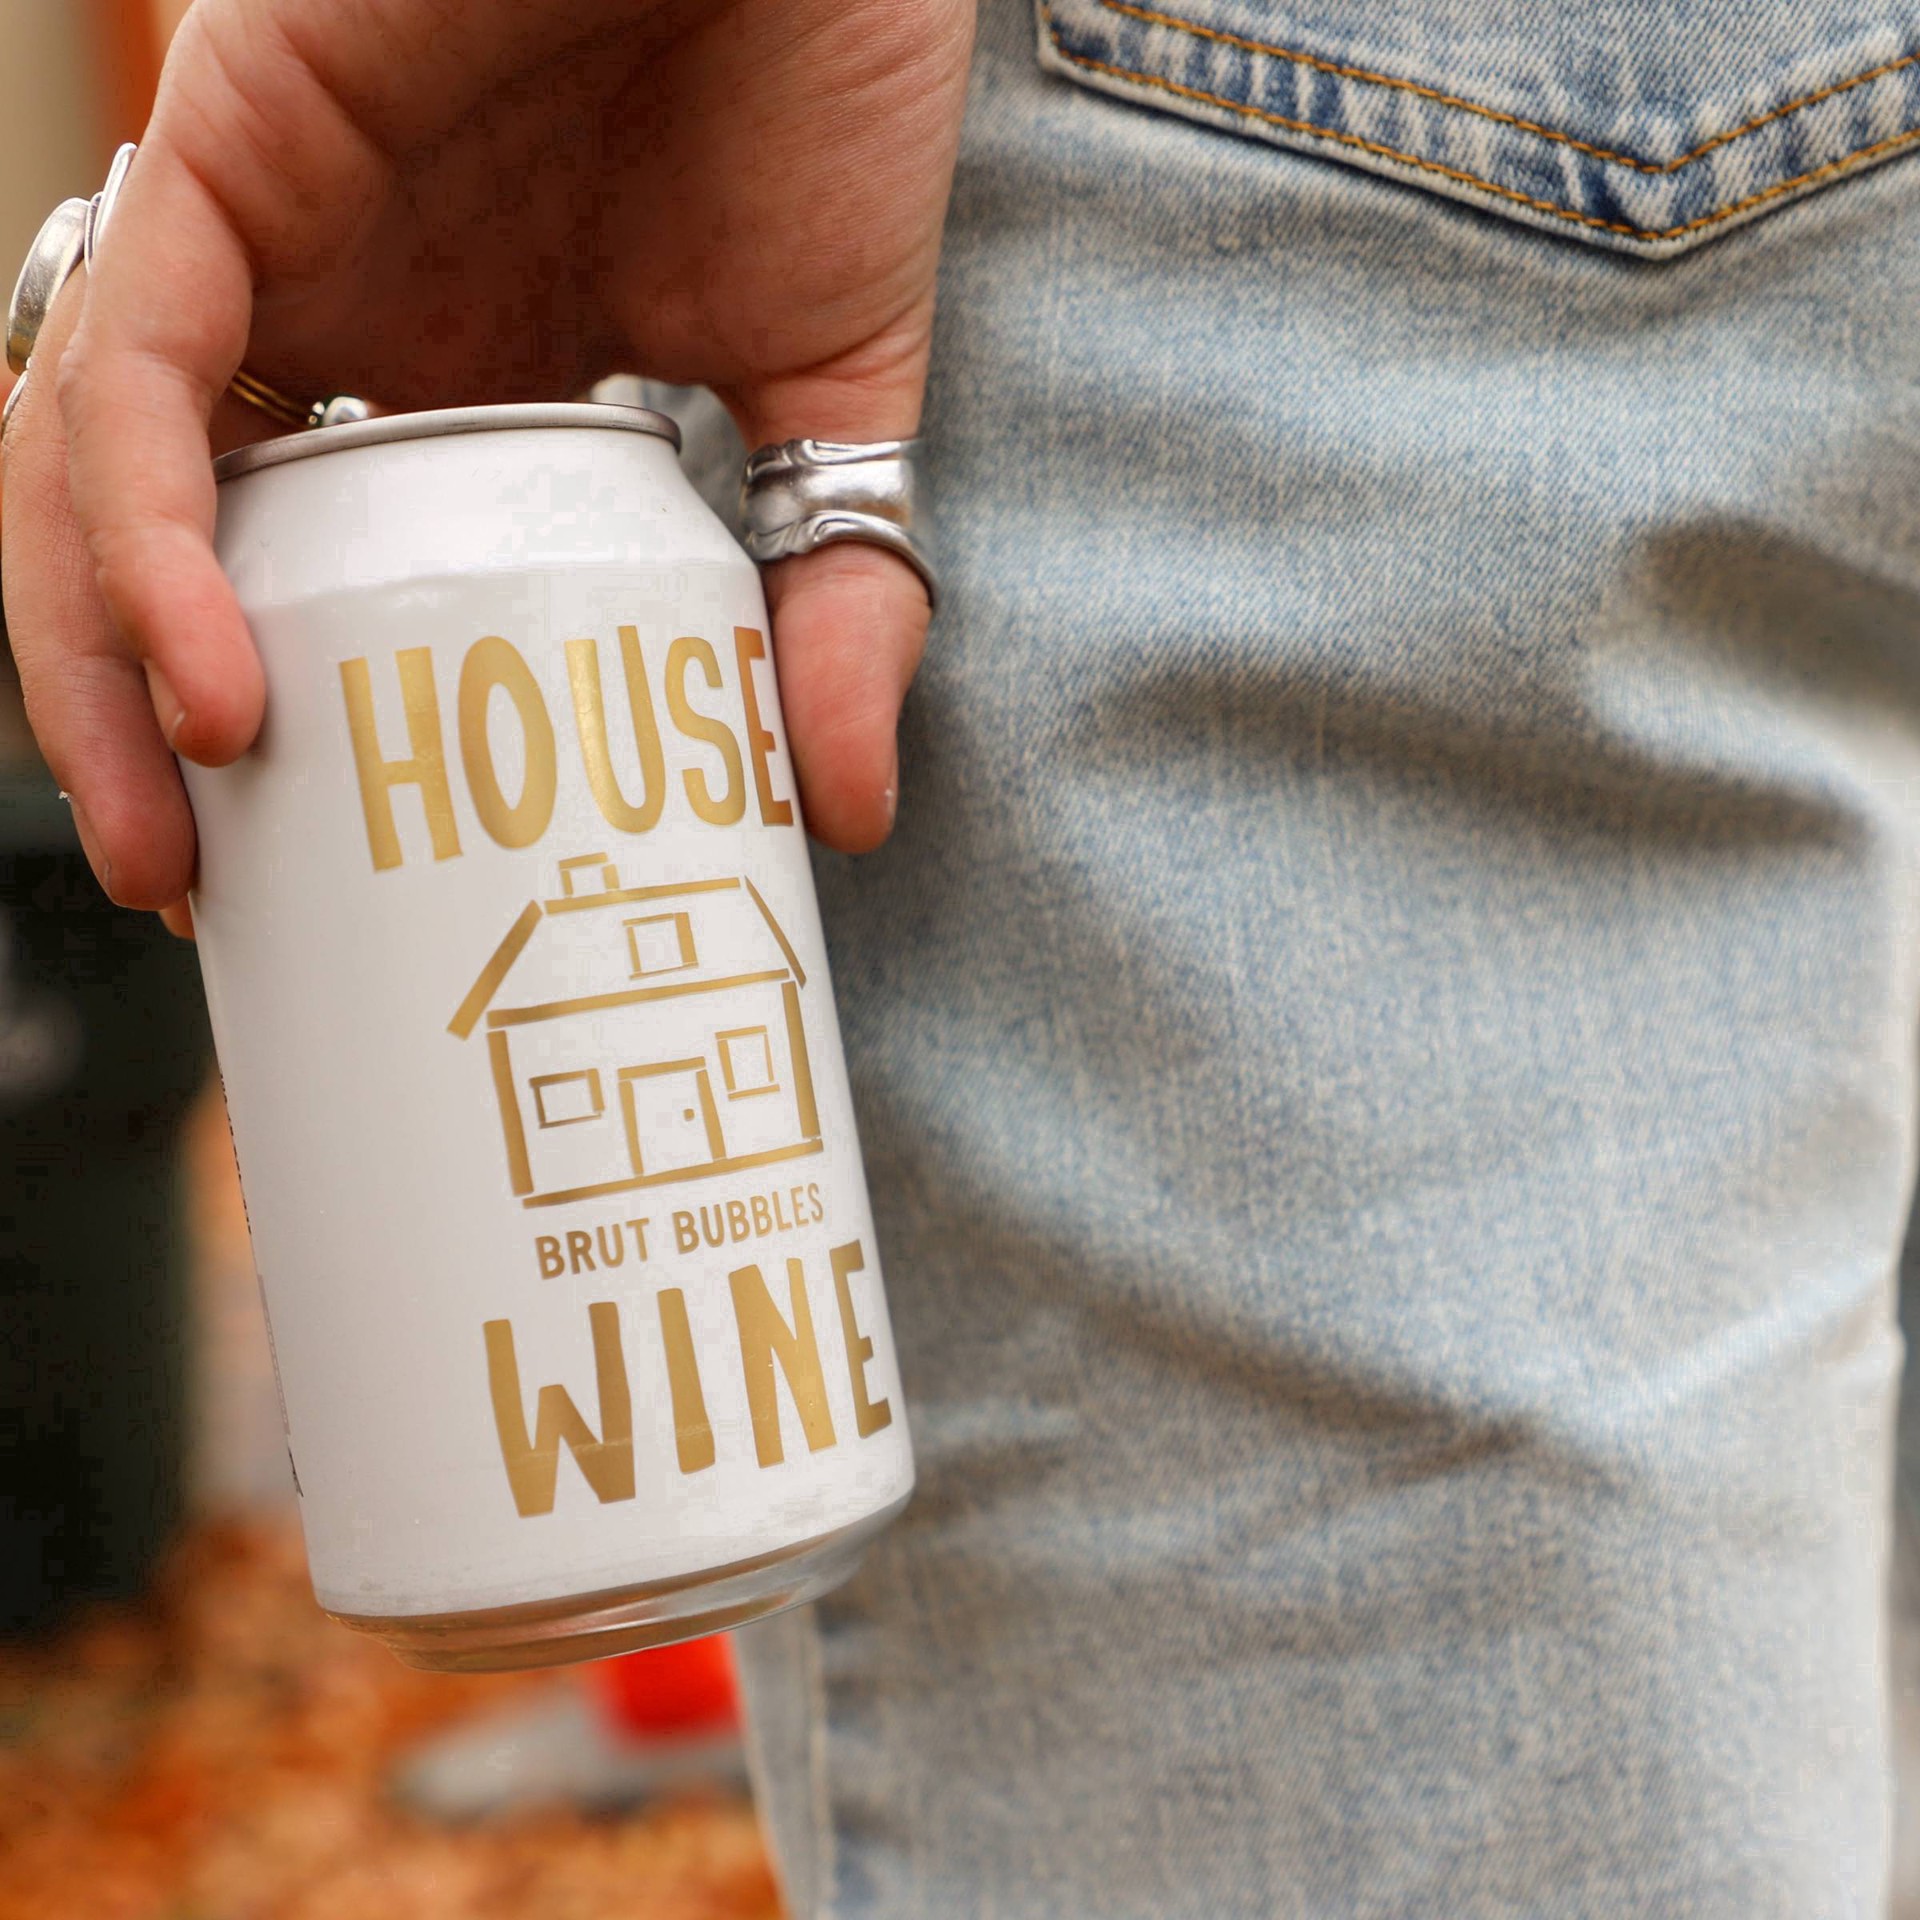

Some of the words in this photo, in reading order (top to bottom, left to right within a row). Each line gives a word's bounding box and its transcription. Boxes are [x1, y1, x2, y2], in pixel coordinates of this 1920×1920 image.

[338, 624, 795, 873] HOUSE
[535, 1217, 650, 1280] BRUT
[672, 1182, 824, 1254] BUBBLES
[482, 1239, 893, 1519] WINE
